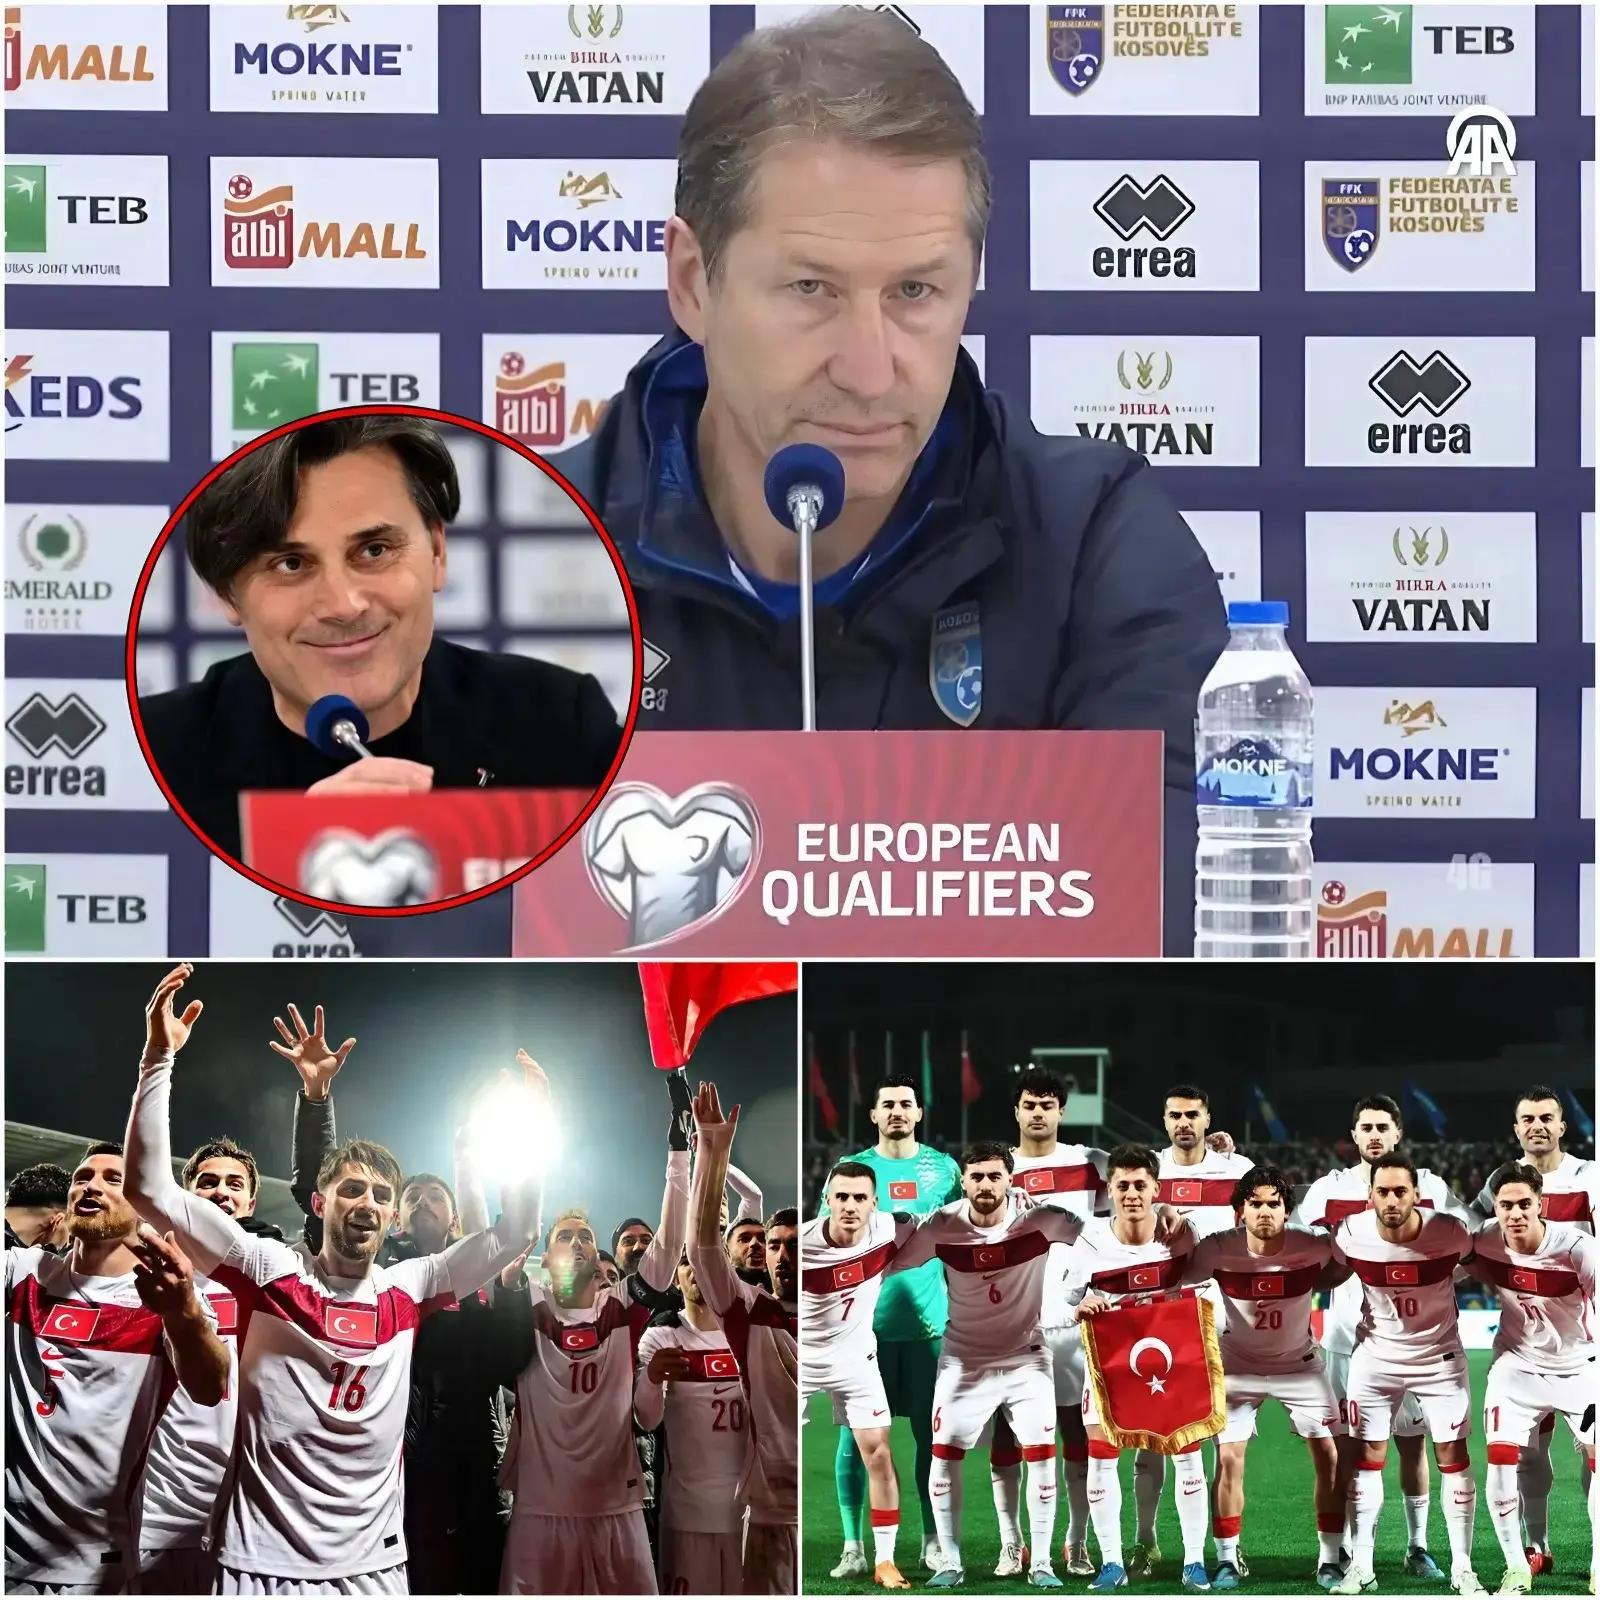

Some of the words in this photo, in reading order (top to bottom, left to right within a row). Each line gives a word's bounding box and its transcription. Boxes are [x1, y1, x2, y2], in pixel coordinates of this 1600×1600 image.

[1113, 5, 1219, 18] FEDERATA
[1224, 5, 1236, 18] E
[1113, 21, 1226, 37] FUTBOLLIT
[1231, 22, 1242, 37] E
[1423, 26, 1515, 54] TEB
[26, 44, 154, 81] MALL
[234, 42, 402, 75] MOKNE
[570, 51, 622, 64] BIRRA
[526, 71, 664, 103] VATAN
[1389, 178, 1496, 194] FEDERATA
[1500, 178, 1512, 194] E
[57, 196, 148, 224] TEB
[1389, 197, 1502, 213] FUTBOLLIT
[1506, 197, 1518, 213] E
[231, 204, 286, 258] albi
[297, 222, 427, 259] MALL
[506, 219, 664, 252] MOKNE
[1092, 246, 1196, 278] errea
[329, 373, 420, 403] TEB
[1119, 404, 1171, 415] BIRRA
[1367, 422, 1472, 454] errea
[1351, 599, 1491, 631] VATAN
[1212, 758, 1287, 776] MOKNE
[1330, 747, 1499, 780] MOKNE
[5, 764, 106, 797] errea
[797, 822, 1060, 863] EUROPEAN
[57, 894, 147, 923] TEB
[762, 869, 1095, 926] QUALIFIERS
[1392, 927, 1521, 957] MALL
[988, 1282, 1003, 1304] 6
[1395, 1297, 1417, 1317] 10
[841, 1297, 855, 1321] 7
[1254, 1310, 1282, 1330] 20
[328, 1361, 371, 1414] 16
[569, 1361, 598, 1394] 10
[711, 1399, 743, 1433] 20
[933, 1407, 942, 1433] 6
